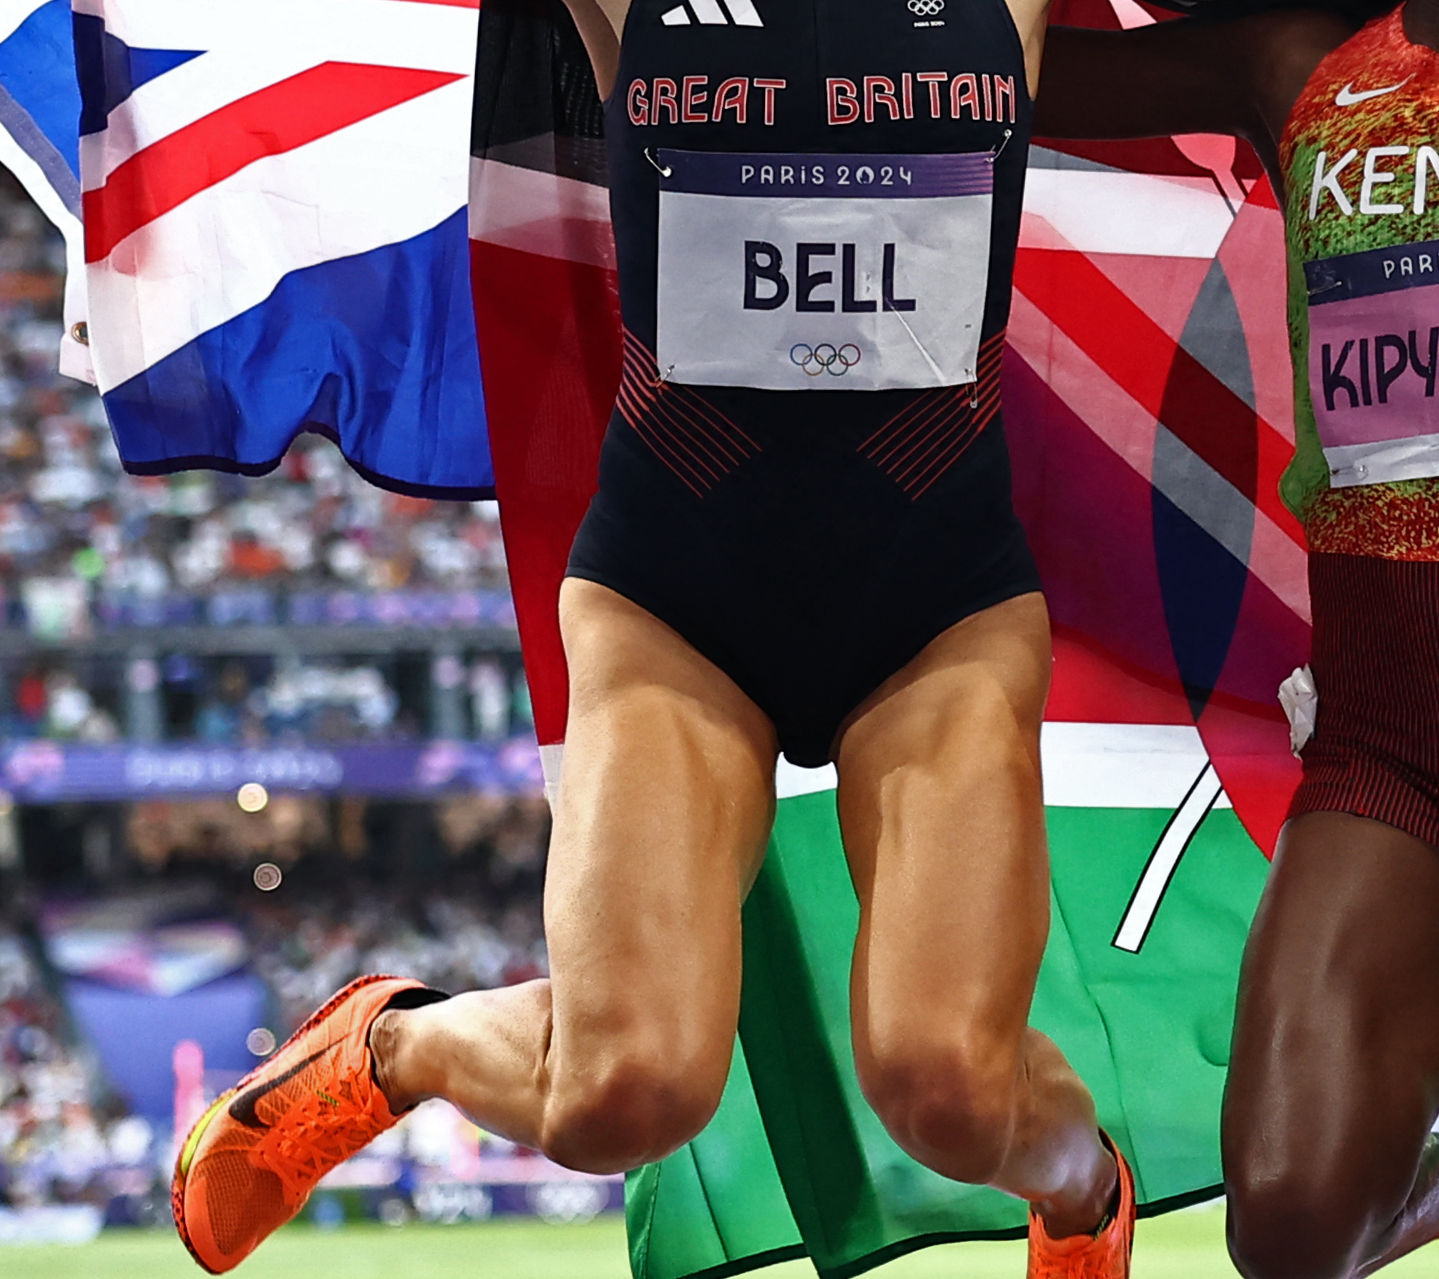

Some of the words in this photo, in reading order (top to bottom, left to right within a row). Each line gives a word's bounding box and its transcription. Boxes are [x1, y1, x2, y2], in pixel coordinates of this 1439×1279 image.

[627, 74, 787, 128] GREAT
[826, 70, 1017, 126] BRITAIN
[837, 163, 913, 186] 2024
[742, 240, 917, 314] BELL
